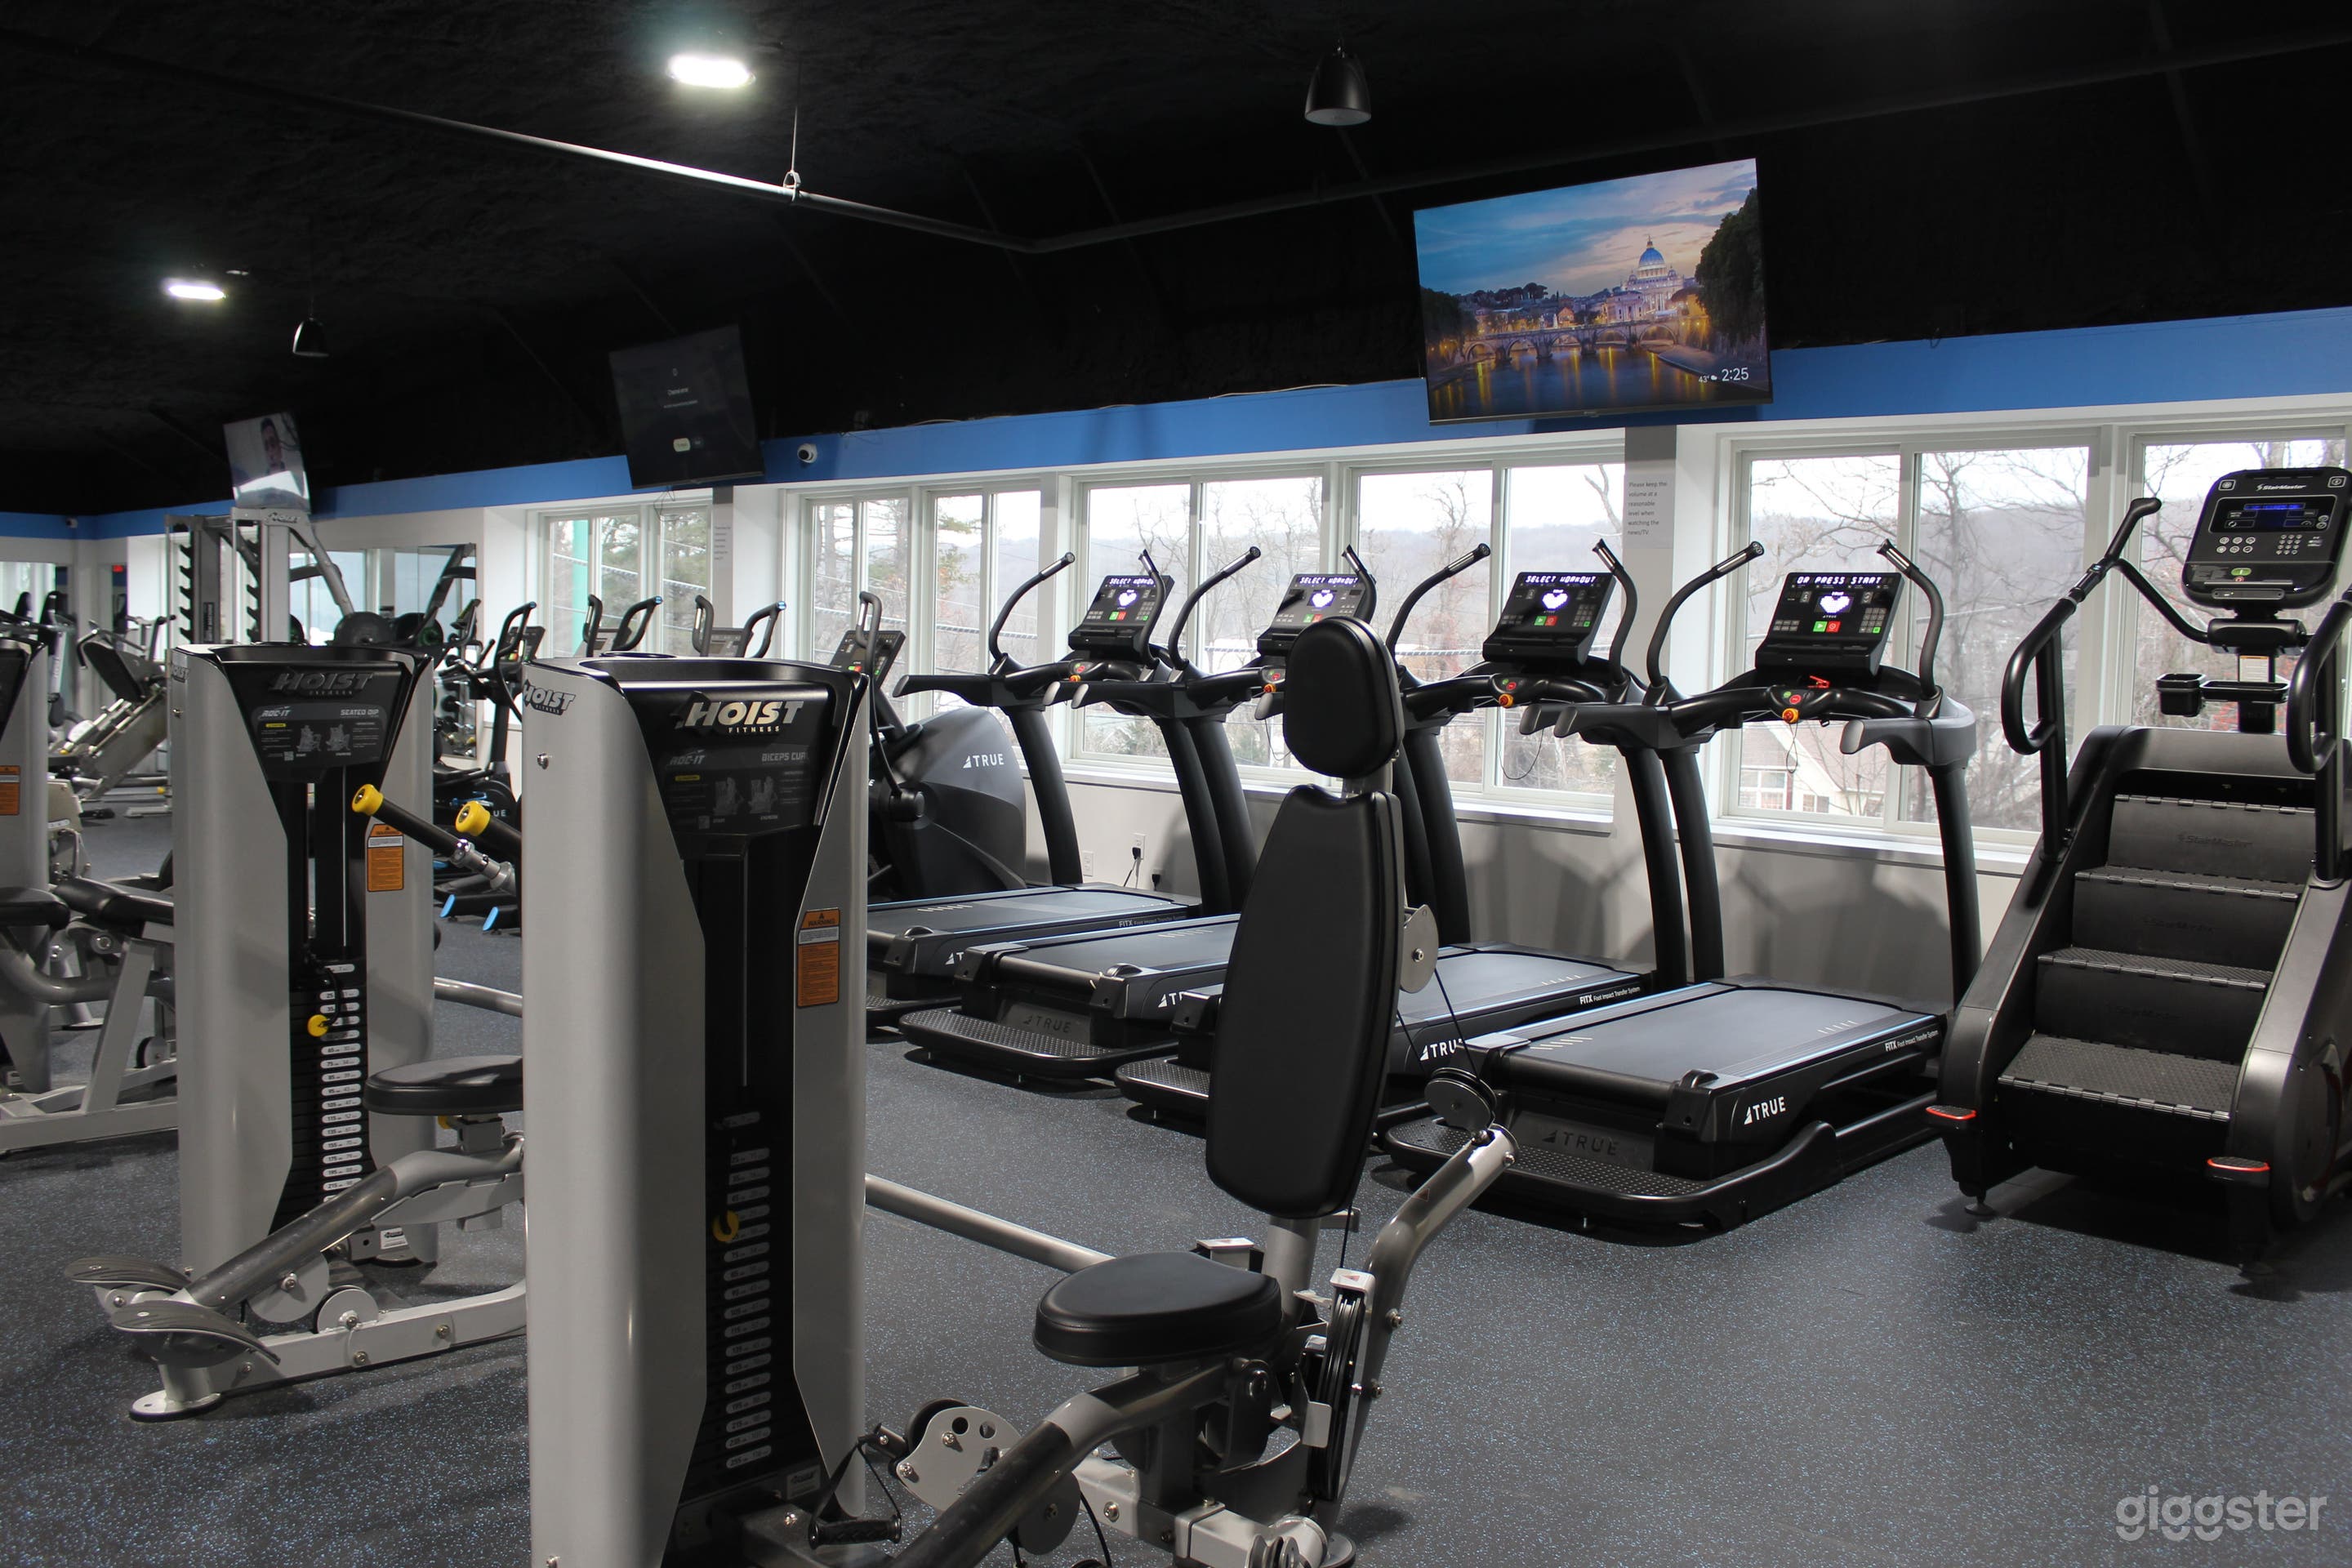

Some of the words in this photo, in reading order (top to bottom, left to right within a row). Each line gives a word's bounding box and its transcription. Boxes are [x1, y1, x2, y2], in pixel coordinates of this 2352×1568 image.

[1722, 368, 1749, 381] 2:25
[1851, 577, 1882, 585] START
[274, 673, 373, 690] HOIST
[523, 684, 576, 710] HOIST
[684, 701, 804, 727] HOIST
[761, 752, 790, 762] BICEPS
[972, 753, 1004, 767] TRUE
[1118, 920, 1133, 928] FITX
[1579, 994, 1593, 1004] FITX
[1036, 1015, 1071, 1033] TRUE
[1885, 1040, 1897, 1052] FITX
[1753, 1096, 1786, 1120] TRUE
[1563, 1131, 1619, 1156] TRUE
